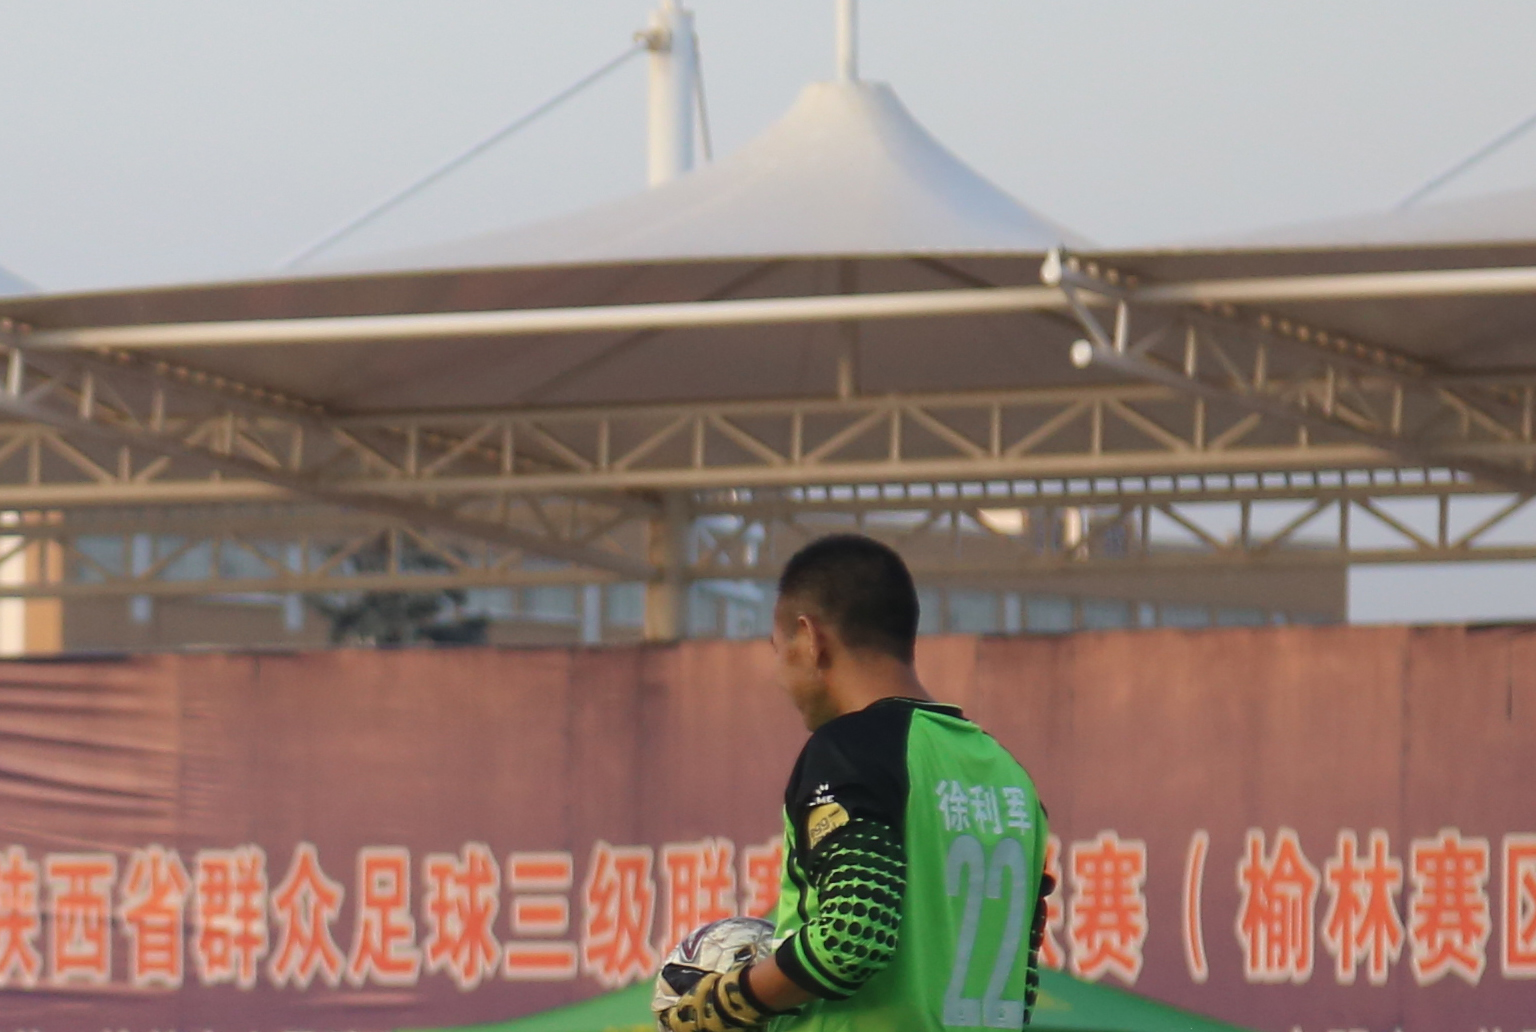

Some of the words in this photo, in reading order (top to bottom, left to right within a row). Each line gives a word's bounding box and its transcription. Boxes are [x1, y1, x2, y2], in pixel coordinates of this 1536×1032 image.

[936, 779, 1032, 836] 徐利军
[944, 837, 1025, 1028] 22
